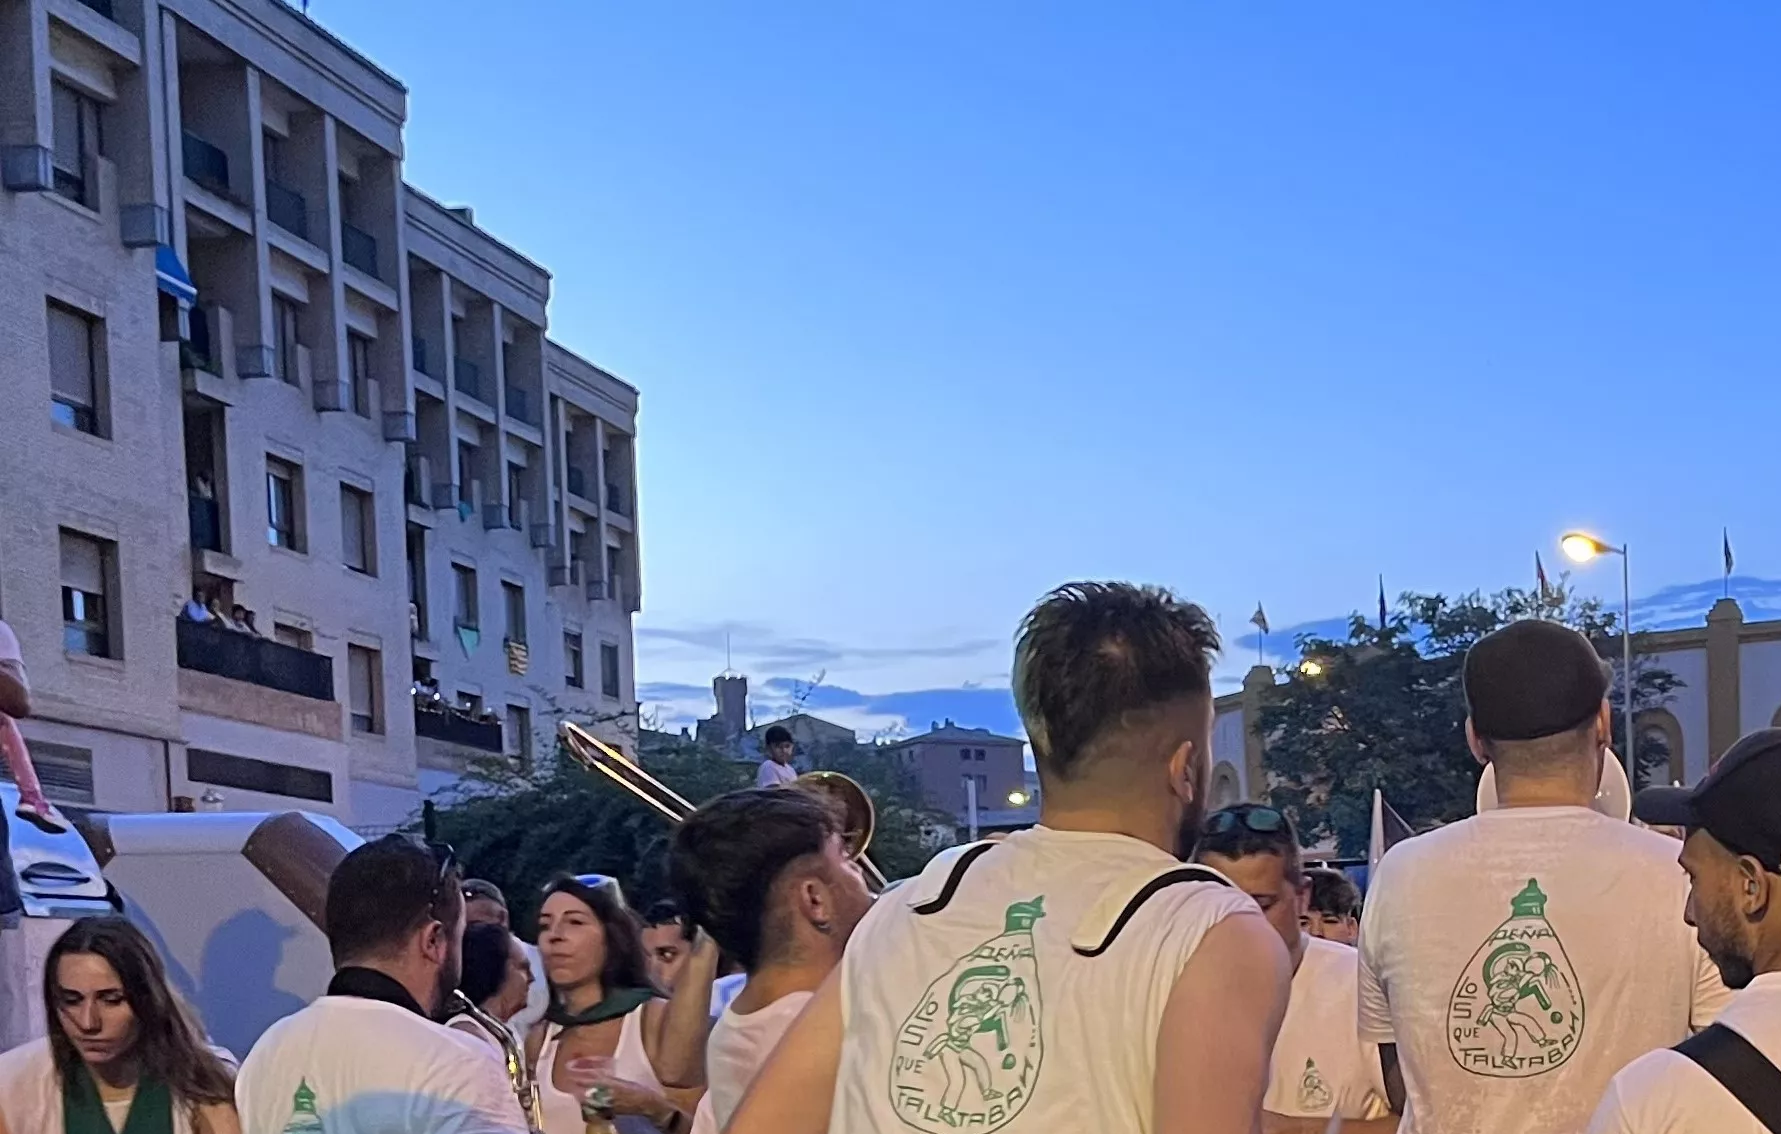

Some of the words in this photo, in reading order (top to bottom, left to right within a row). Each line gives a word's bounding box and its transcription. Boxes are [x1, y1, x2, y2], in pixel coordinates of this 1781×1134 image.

[1488, 925, 1555, 947] PEÑA
[967, 944, 1034, 963] PEÑA
[1452, 1027, 1480, 1044] QUE
[896, 1055, 924, 1076] QUE
